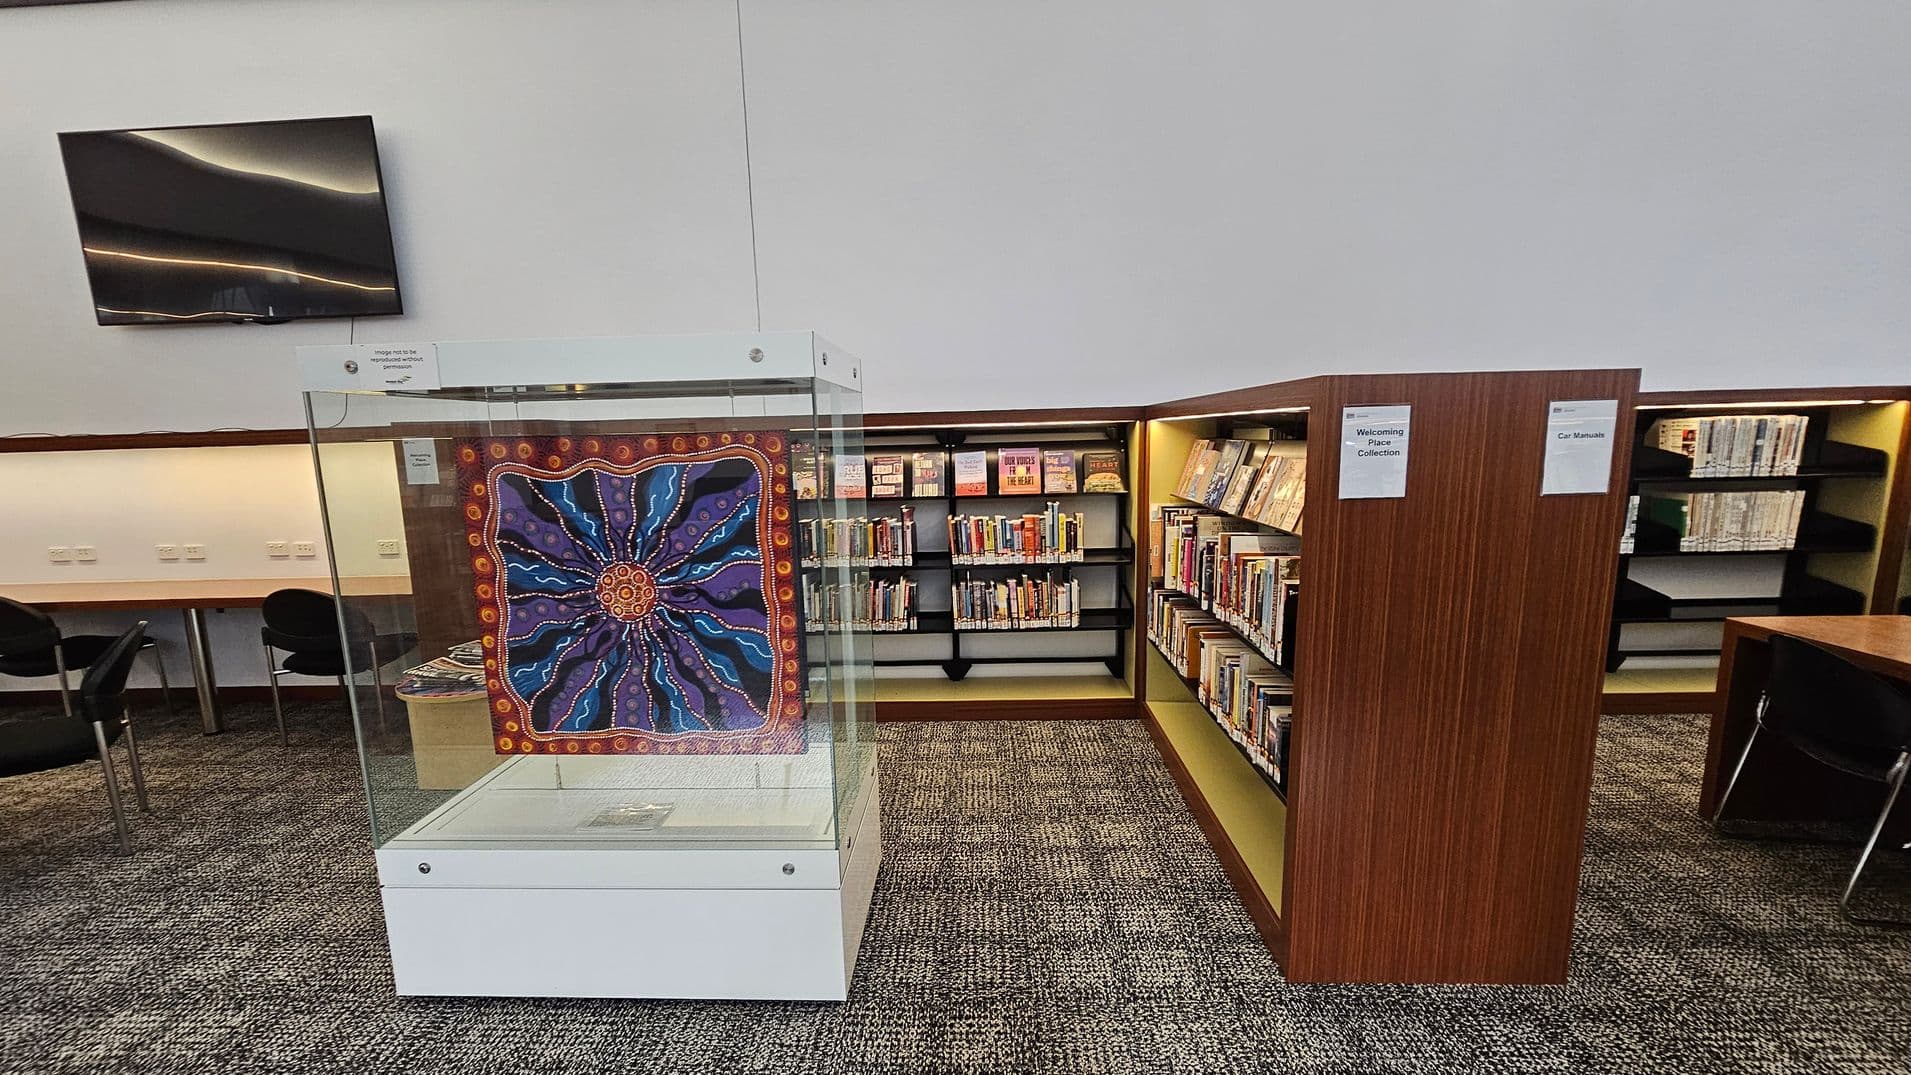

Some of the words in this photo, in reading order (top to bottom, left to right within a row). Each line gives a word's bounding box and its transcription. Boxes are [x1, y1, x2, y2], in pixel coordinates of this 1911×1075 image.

[1356, 428, 1404, 436] Welcoming
[1573, 431, 1605, 439] Manuals
[1357, 449, 1401, 457] Collection
[1004, 457, 1016, 466] OUR
[1017, 456, 1036, 465] VOICES
[1089, 461, 1119, 469] HEART
[1007, 477, 1017, 486] THE
[1018, 476, 1034, 486] HEART
